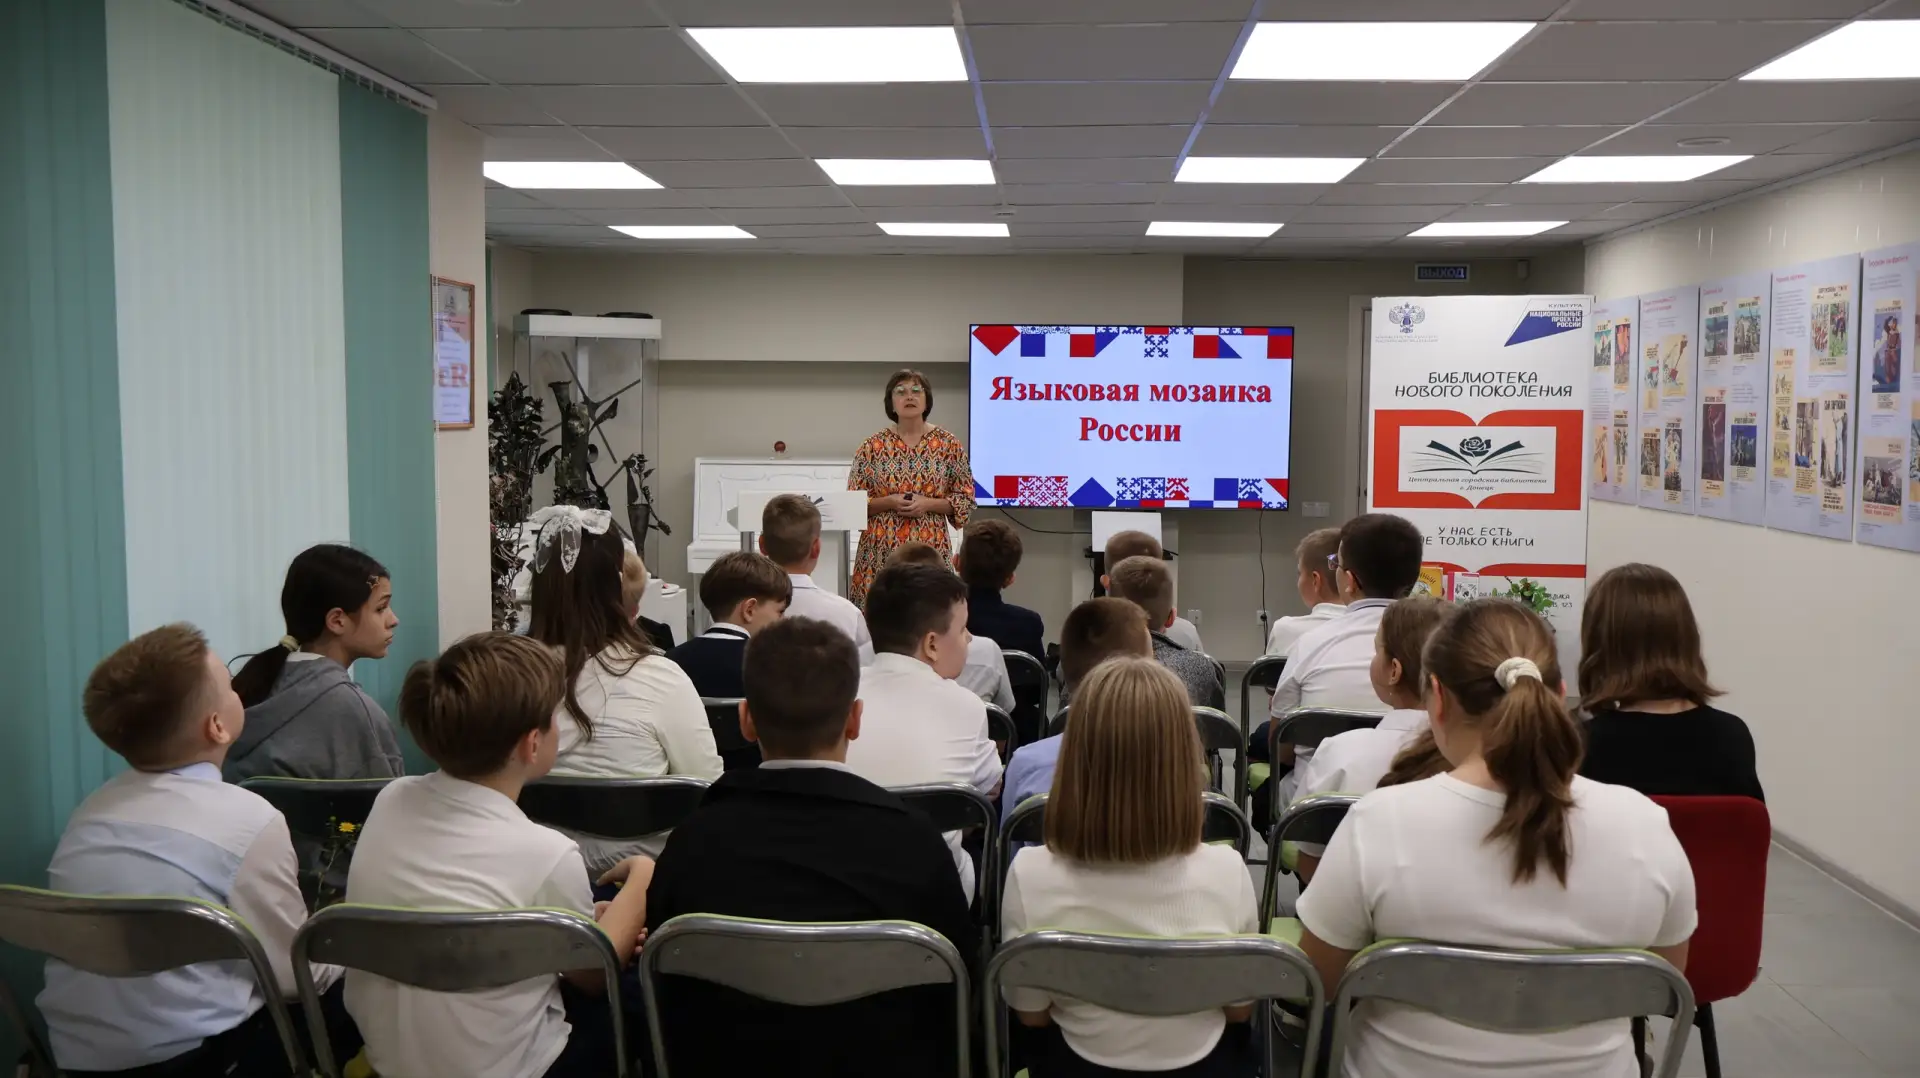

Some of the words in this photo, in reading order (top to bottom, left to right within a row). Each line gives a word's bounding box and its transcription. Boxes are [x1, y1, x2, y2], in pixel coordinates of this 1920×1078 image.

[1420, 267, 1464, 278] ВЫХОД
[1428, 371, 1538, 384] БИБЛИОТЕКА
[989, 376, 1139, 401] Языковая
[1149, 384, 1272, 402] мозаика
[1395, 385, 1463, 397] НОВОГО
[1469, 385, 1573, 397] ПОКОЛЕНИЯ
[1078, 416, 1182, 442] России
[1408, 476, 1460, 484] Центральная
[1461, 476, 1499, 484] городская
[1500, 476, 1547, 484] библиотека
[1438, 527, 1446, 536] У
[1450, 527, 1474, 536] НАС
[1480, 527, 1512, 536] ЕСТЬ
[1439, 537, 1487, 546] ТОЛЬКО
[1493, 537, 1534, 546] КНИГИ
